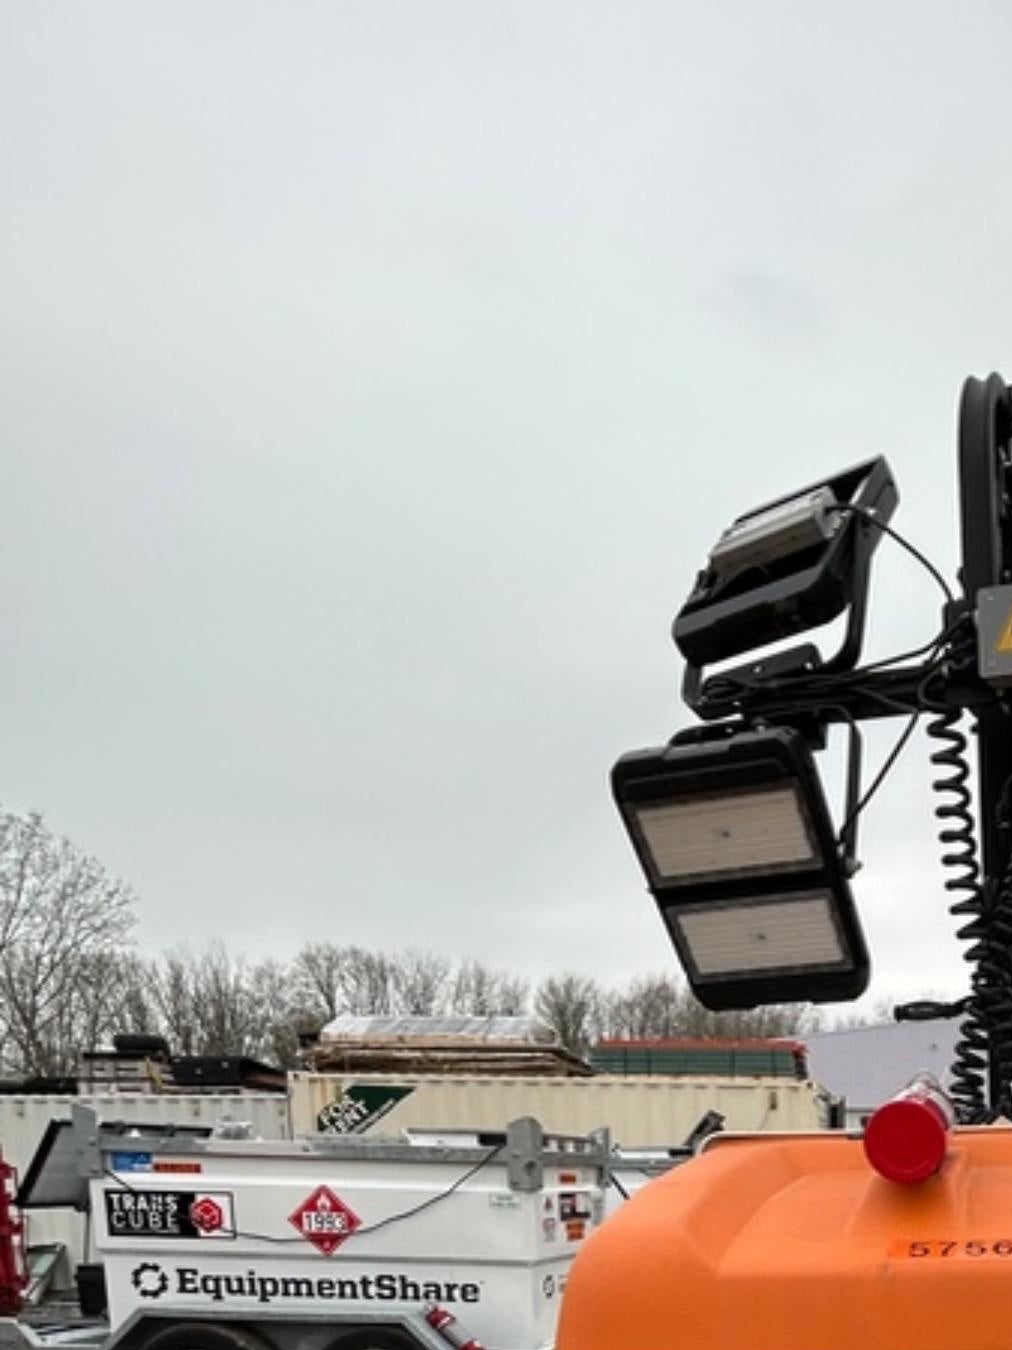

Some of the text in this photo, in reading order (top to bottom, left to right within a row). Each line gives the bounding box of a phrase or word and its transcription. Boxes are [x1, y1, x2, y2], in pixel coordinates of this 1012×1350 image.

[109, 1193, 178, 1212] TRANS
[112, 1211, 179, 1229] CUBE
[176, 1266, 481, 1303] EquipmentShare
